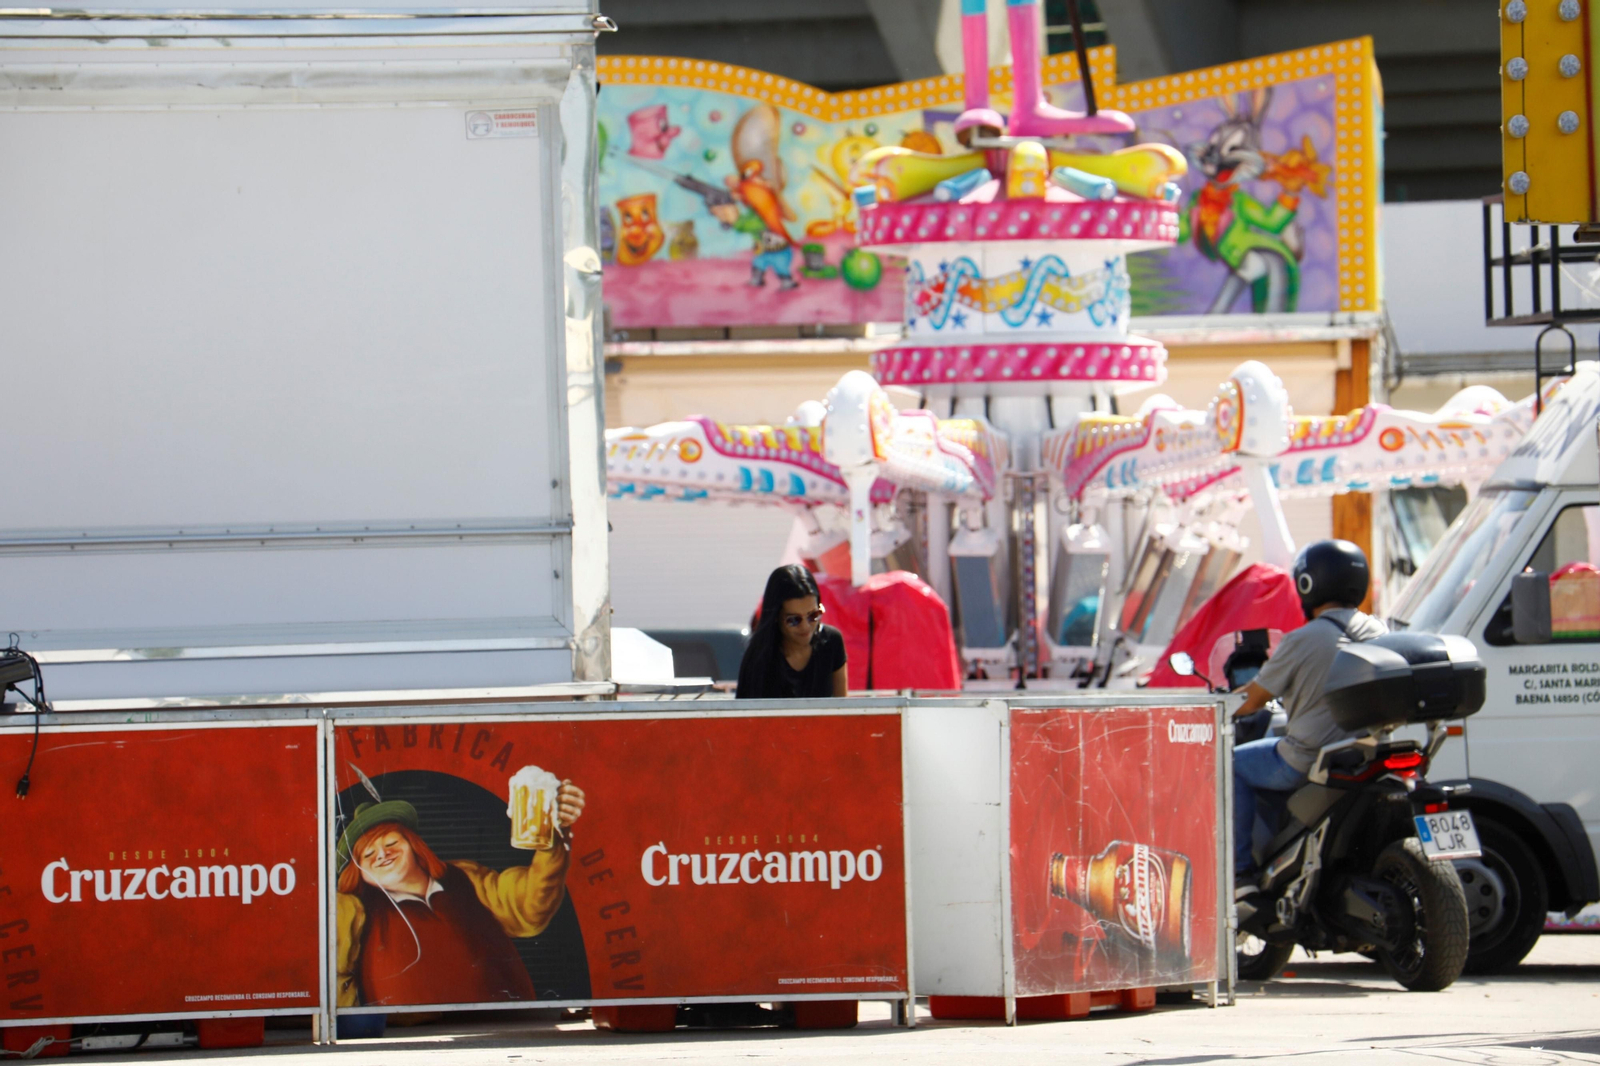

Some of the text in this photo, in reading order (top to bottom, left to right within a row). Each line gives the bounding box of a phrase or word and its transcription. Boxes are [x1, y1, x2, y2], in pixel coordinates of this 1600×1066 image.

[1508, 662, 1600, 675] MARGARITA ROLD
[1540, 679, 1572, 688] SANTA
[1516, 694, 1551, 704] BAENA
[1168, 719, 1213, 746] Cruzcampo
[347, 724, 514, 772] FABRICA
[1429, 815, 1470, 834] 8048
[702, 834, 819, 845] DESDE 1904
[1434, 834, 1466, 850] LJR
[109, 848, 229, 861] DESDE 1904
[640, 840, 883, 890] Cruzcampo
[40, 856, 297, 905] Cruzcampo
[579, 848, 645, 990] DE CERV
[184, 994, 214, 1003] CRUZCAMPO
[214, 993, 246, 1001] RECOMIENDA
[252, 992, 276, 1000] CONSUMO
[276, 990, 311, 999] RESPONSABLE.
